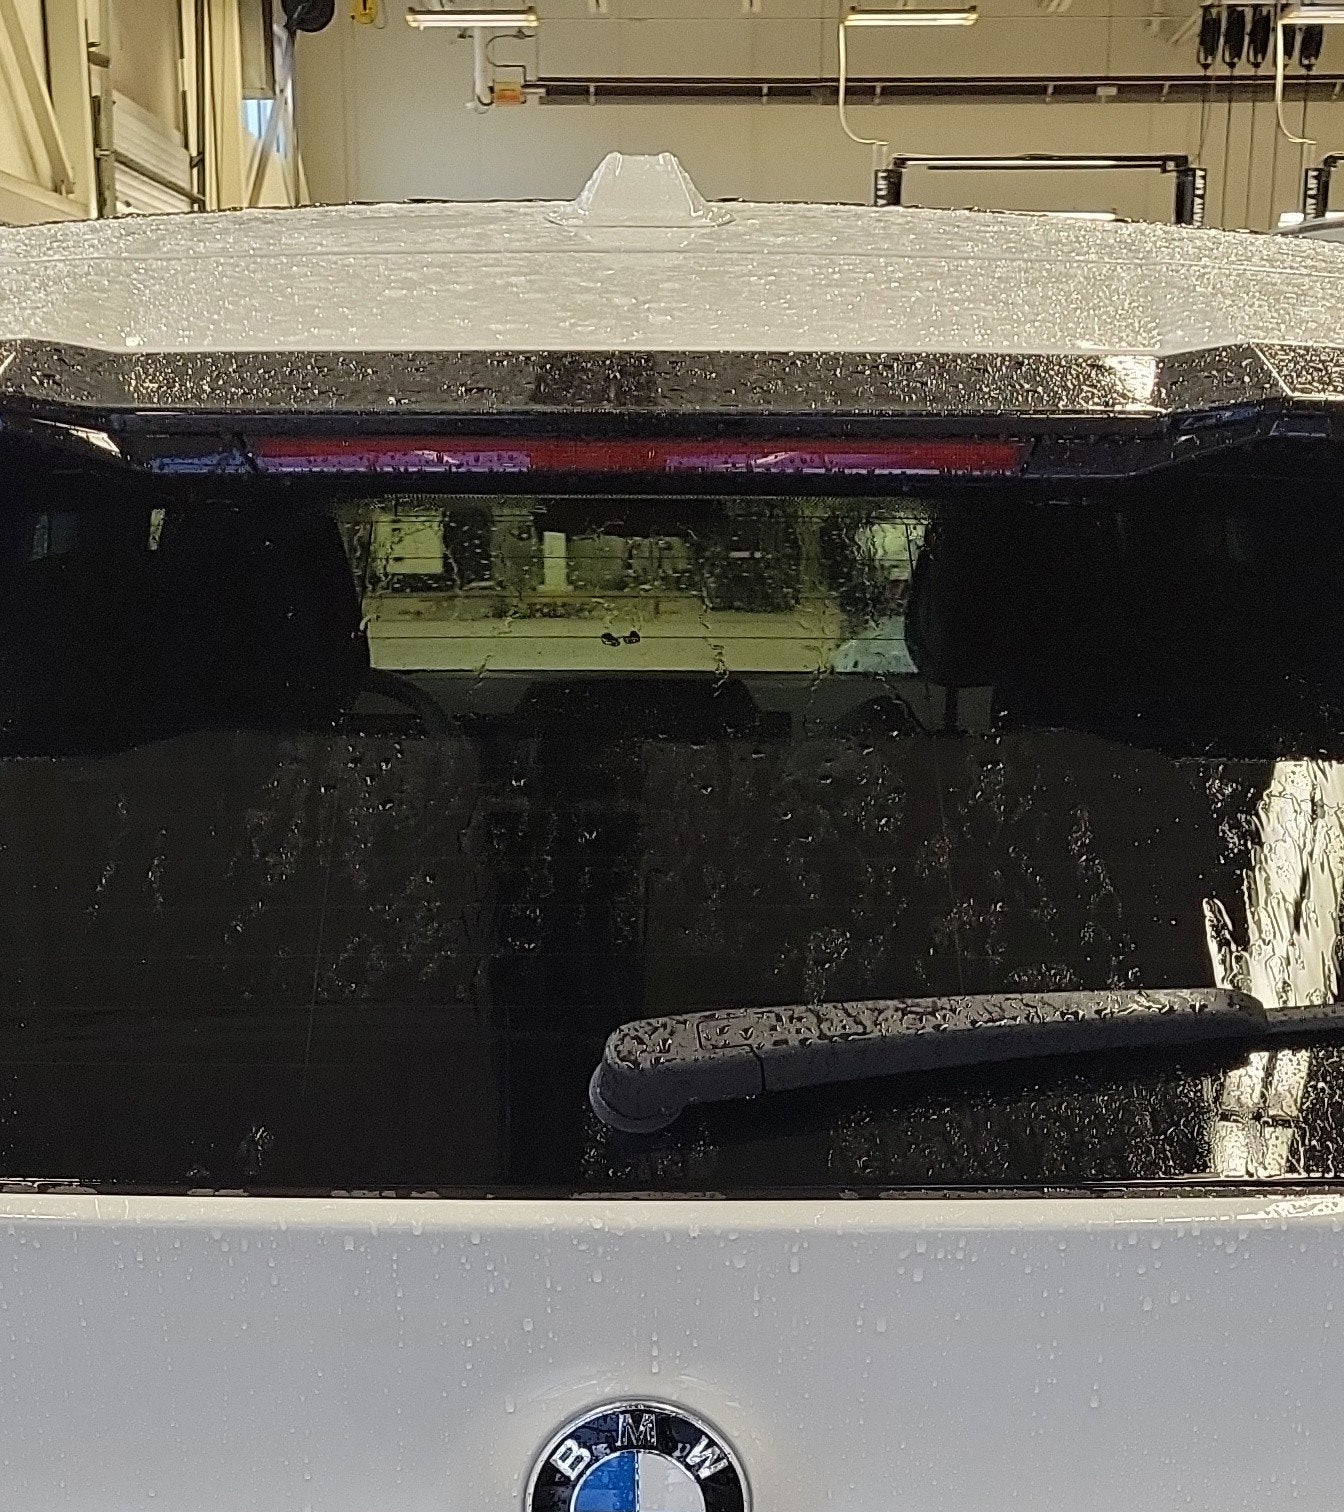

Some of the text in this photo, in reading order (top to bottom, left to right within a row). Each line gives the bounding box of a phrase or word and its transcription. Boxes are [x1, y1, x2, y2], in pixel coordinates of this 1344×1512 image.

[1194, 169, 1206, 195] LIFT
[1306, 170, 1319, 195] LIFT
[549, 1411, 729, 1482] BMW
